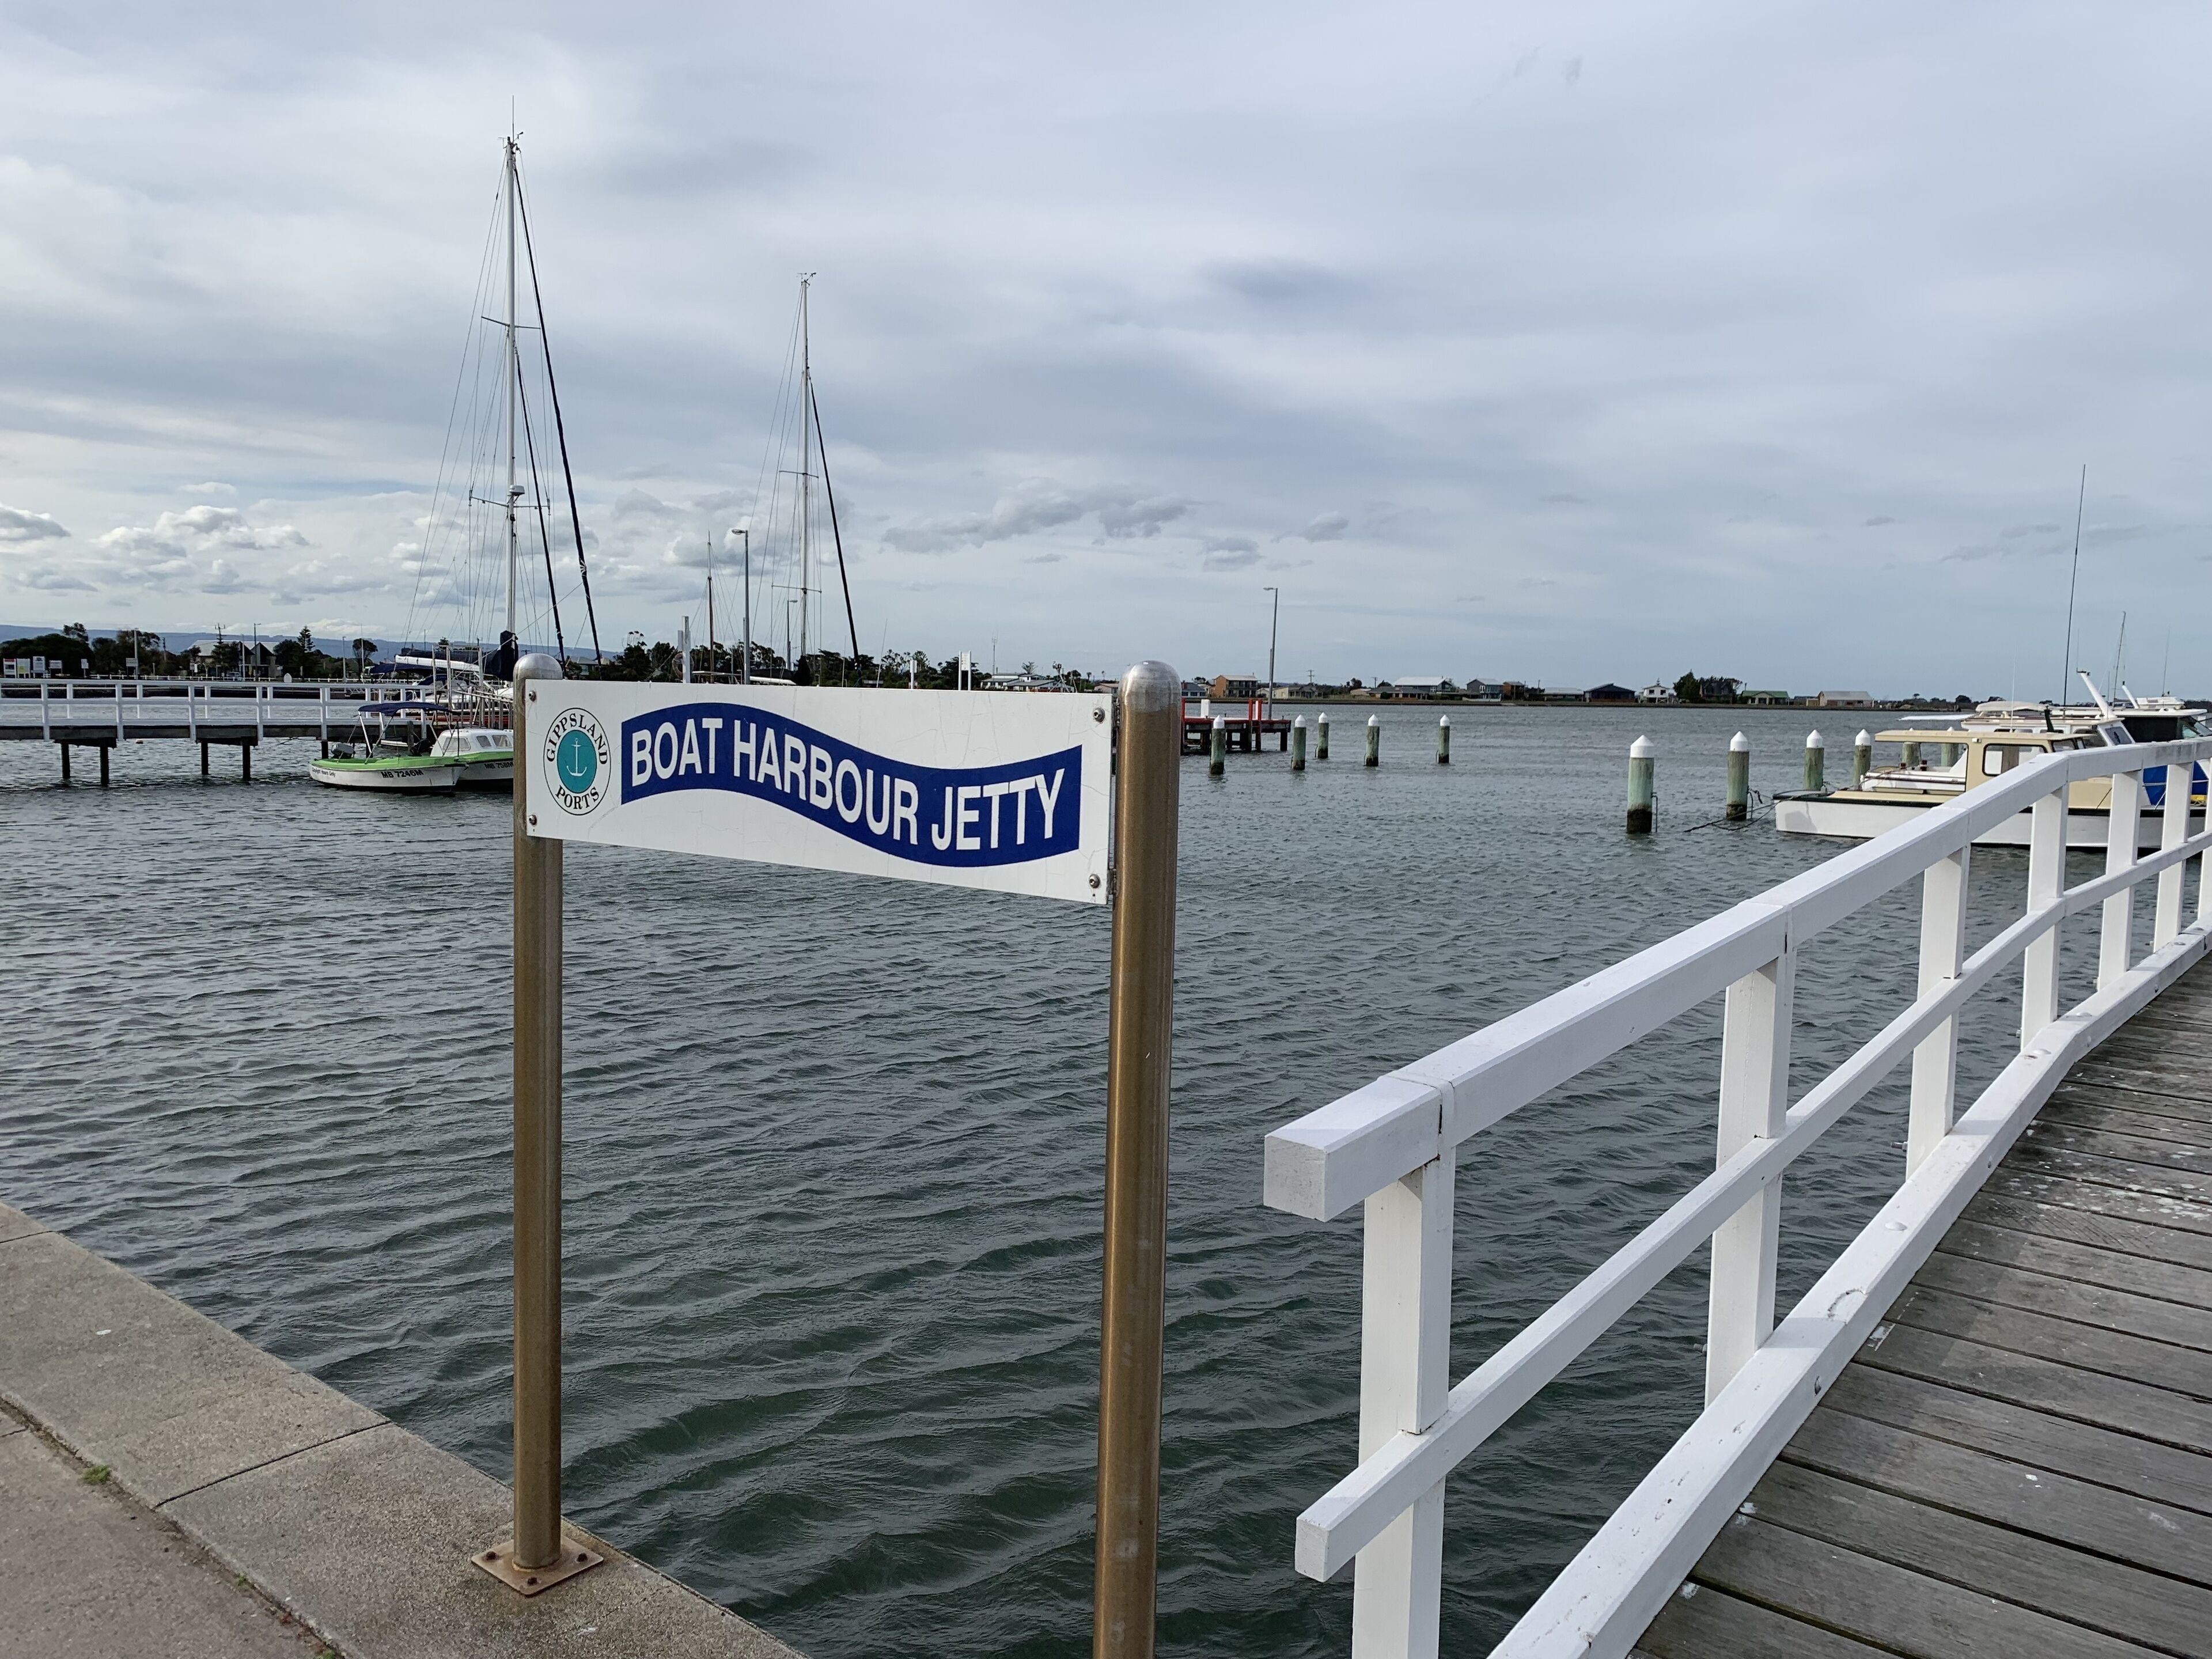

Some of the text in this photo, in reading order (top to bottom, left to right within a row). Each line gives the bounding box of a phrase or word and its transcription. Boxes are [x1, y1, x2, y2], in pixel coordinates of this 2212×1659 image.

[547, 713, 608, 764] GIPPSLAND
[394, 769, 424, 778] 7246M
[632, 718, 1065, 851] BOAT HARBOUR JETTY
[555, 784, 600, 809] PORTS
